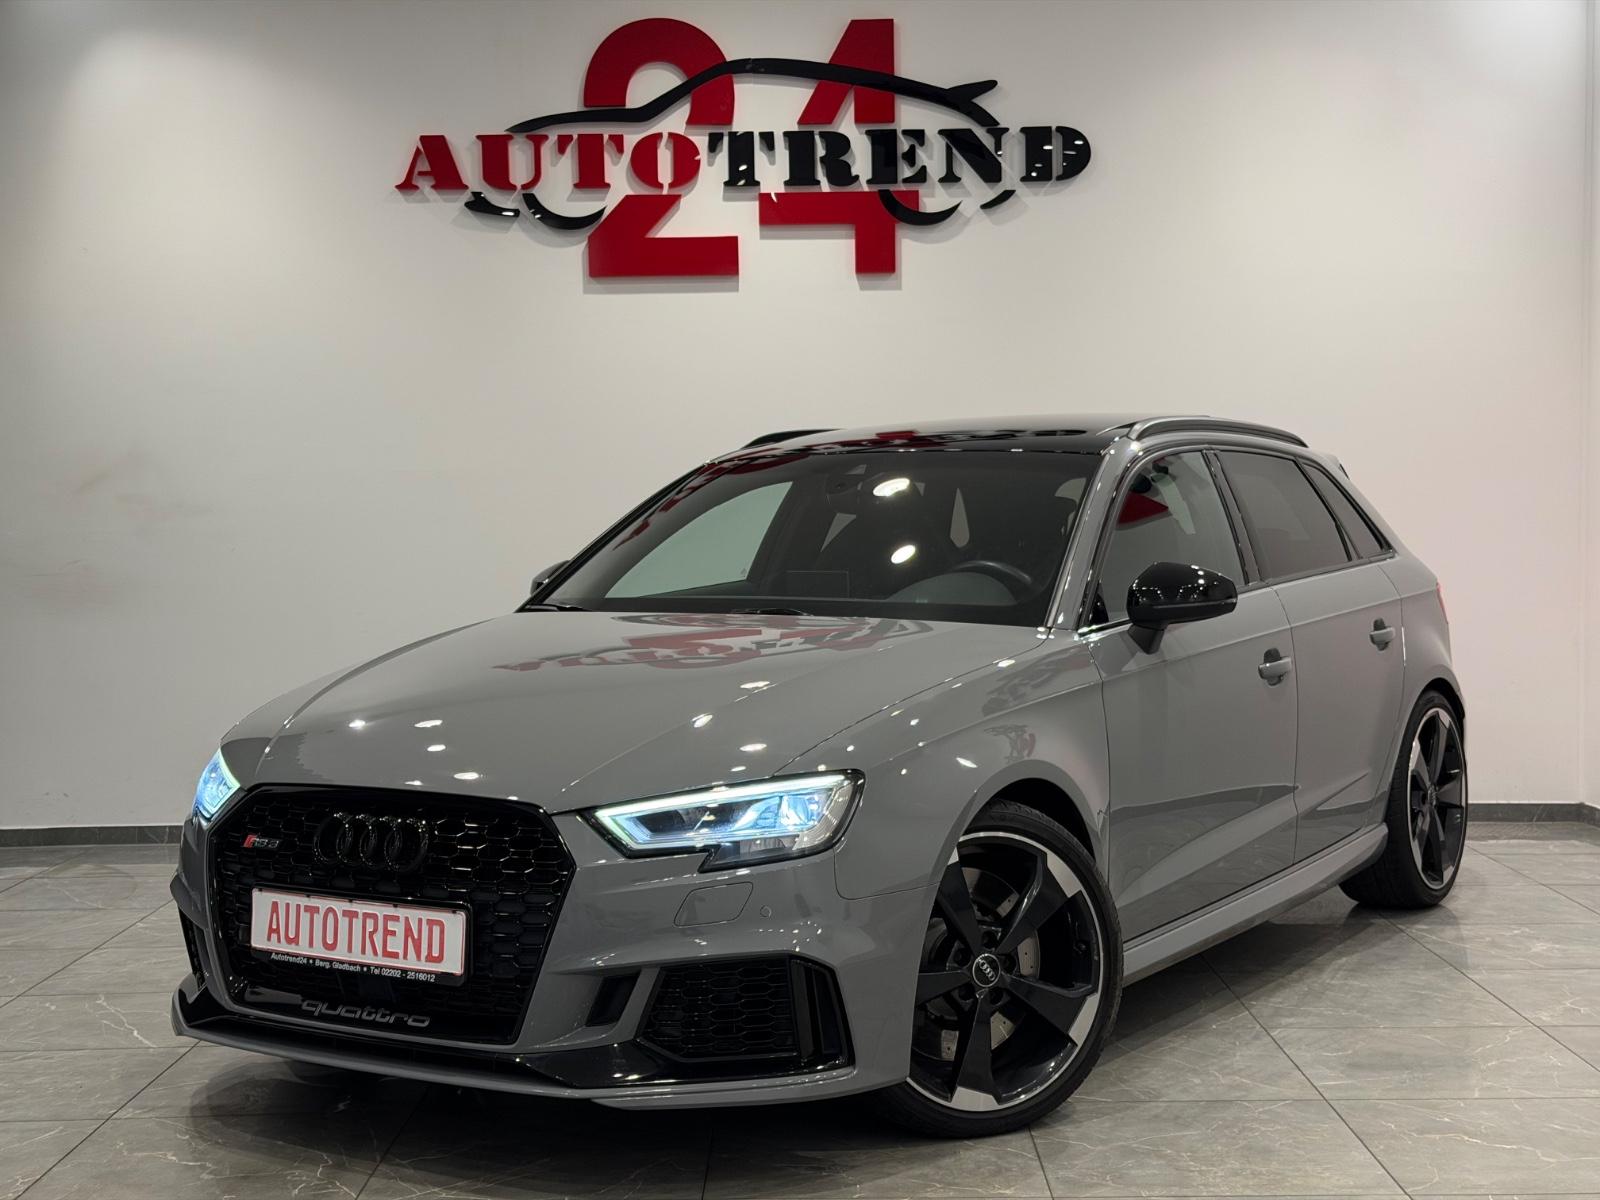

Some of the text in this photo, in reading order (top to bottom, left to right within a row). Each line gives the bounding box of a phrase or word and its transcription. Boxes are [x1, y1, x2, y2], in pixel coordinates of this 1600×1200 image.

[395, 126, 1092, 194] AUTOTREND
[583, 18, 919, 277] 24
[266, 900, 446, 964] AUTOTREND
[271, 952, 308, 964] Autotrend24
[315, 959, 331, 969] Berg.
[332, 961, 361, 972] Gladbach
[370, 966, 381, 975] Tel
[381, 968, 402, 978] 02202
[406, 971, 436, 982] 2516012
[301, 999, 431, 1028] quattro
